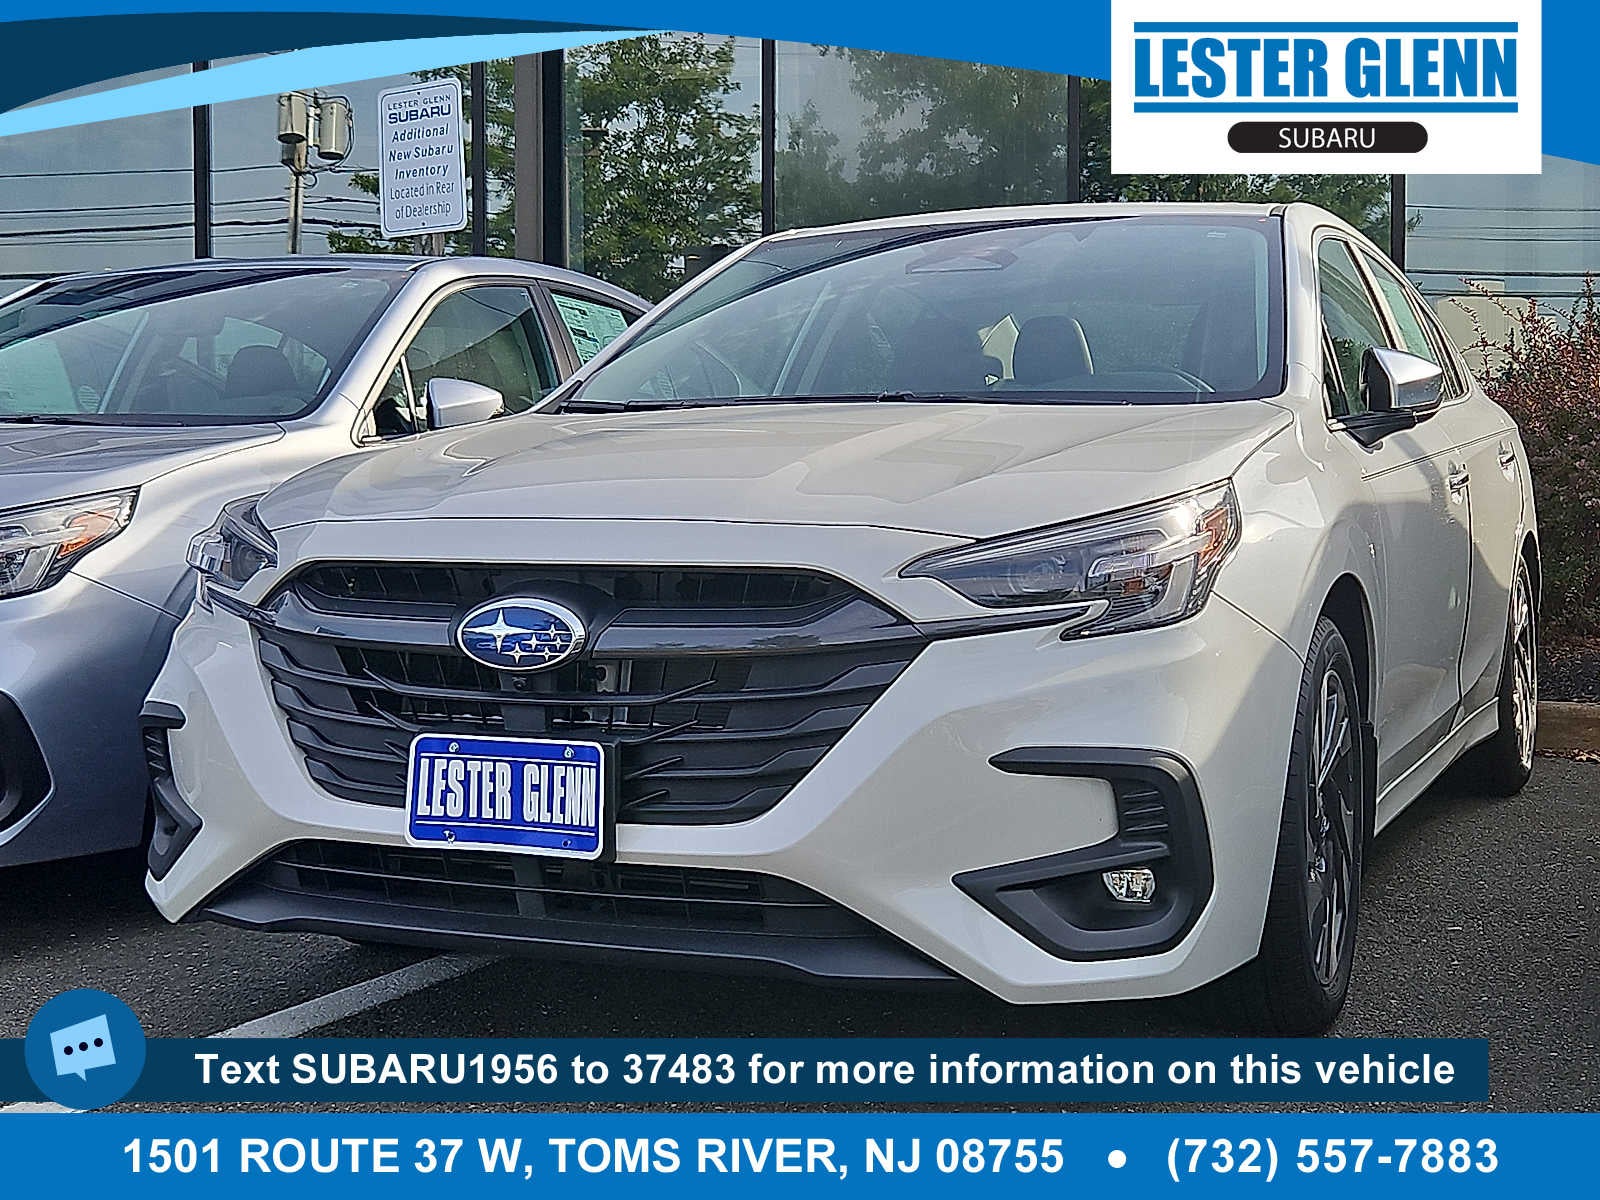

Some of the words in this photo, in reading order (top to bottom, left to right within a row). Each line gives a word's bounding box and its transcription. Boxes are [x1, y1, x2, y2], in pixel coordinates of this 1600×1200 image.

[388, 99, 419, 111] LESTER
[422, 95, 451, 105] GLENN
[388, 103, 451, 124] SUBARU
[392, 123, 450, 143] Additional
[389, 150, 411, 162] New
[413, 144, 454, 159] Subaru
[395, 164, 449, 180] Inventory
[390, 184, 425, 200] Located
[426, 184, 435, 195] in
[436, 181, 455, 194] Rear
[395, 206, 405, 219] of
[405, 202, 451, 219] Dealership
[416, 757, 513, 820] LESTER
[522, 763, 597, 827] GLENN
